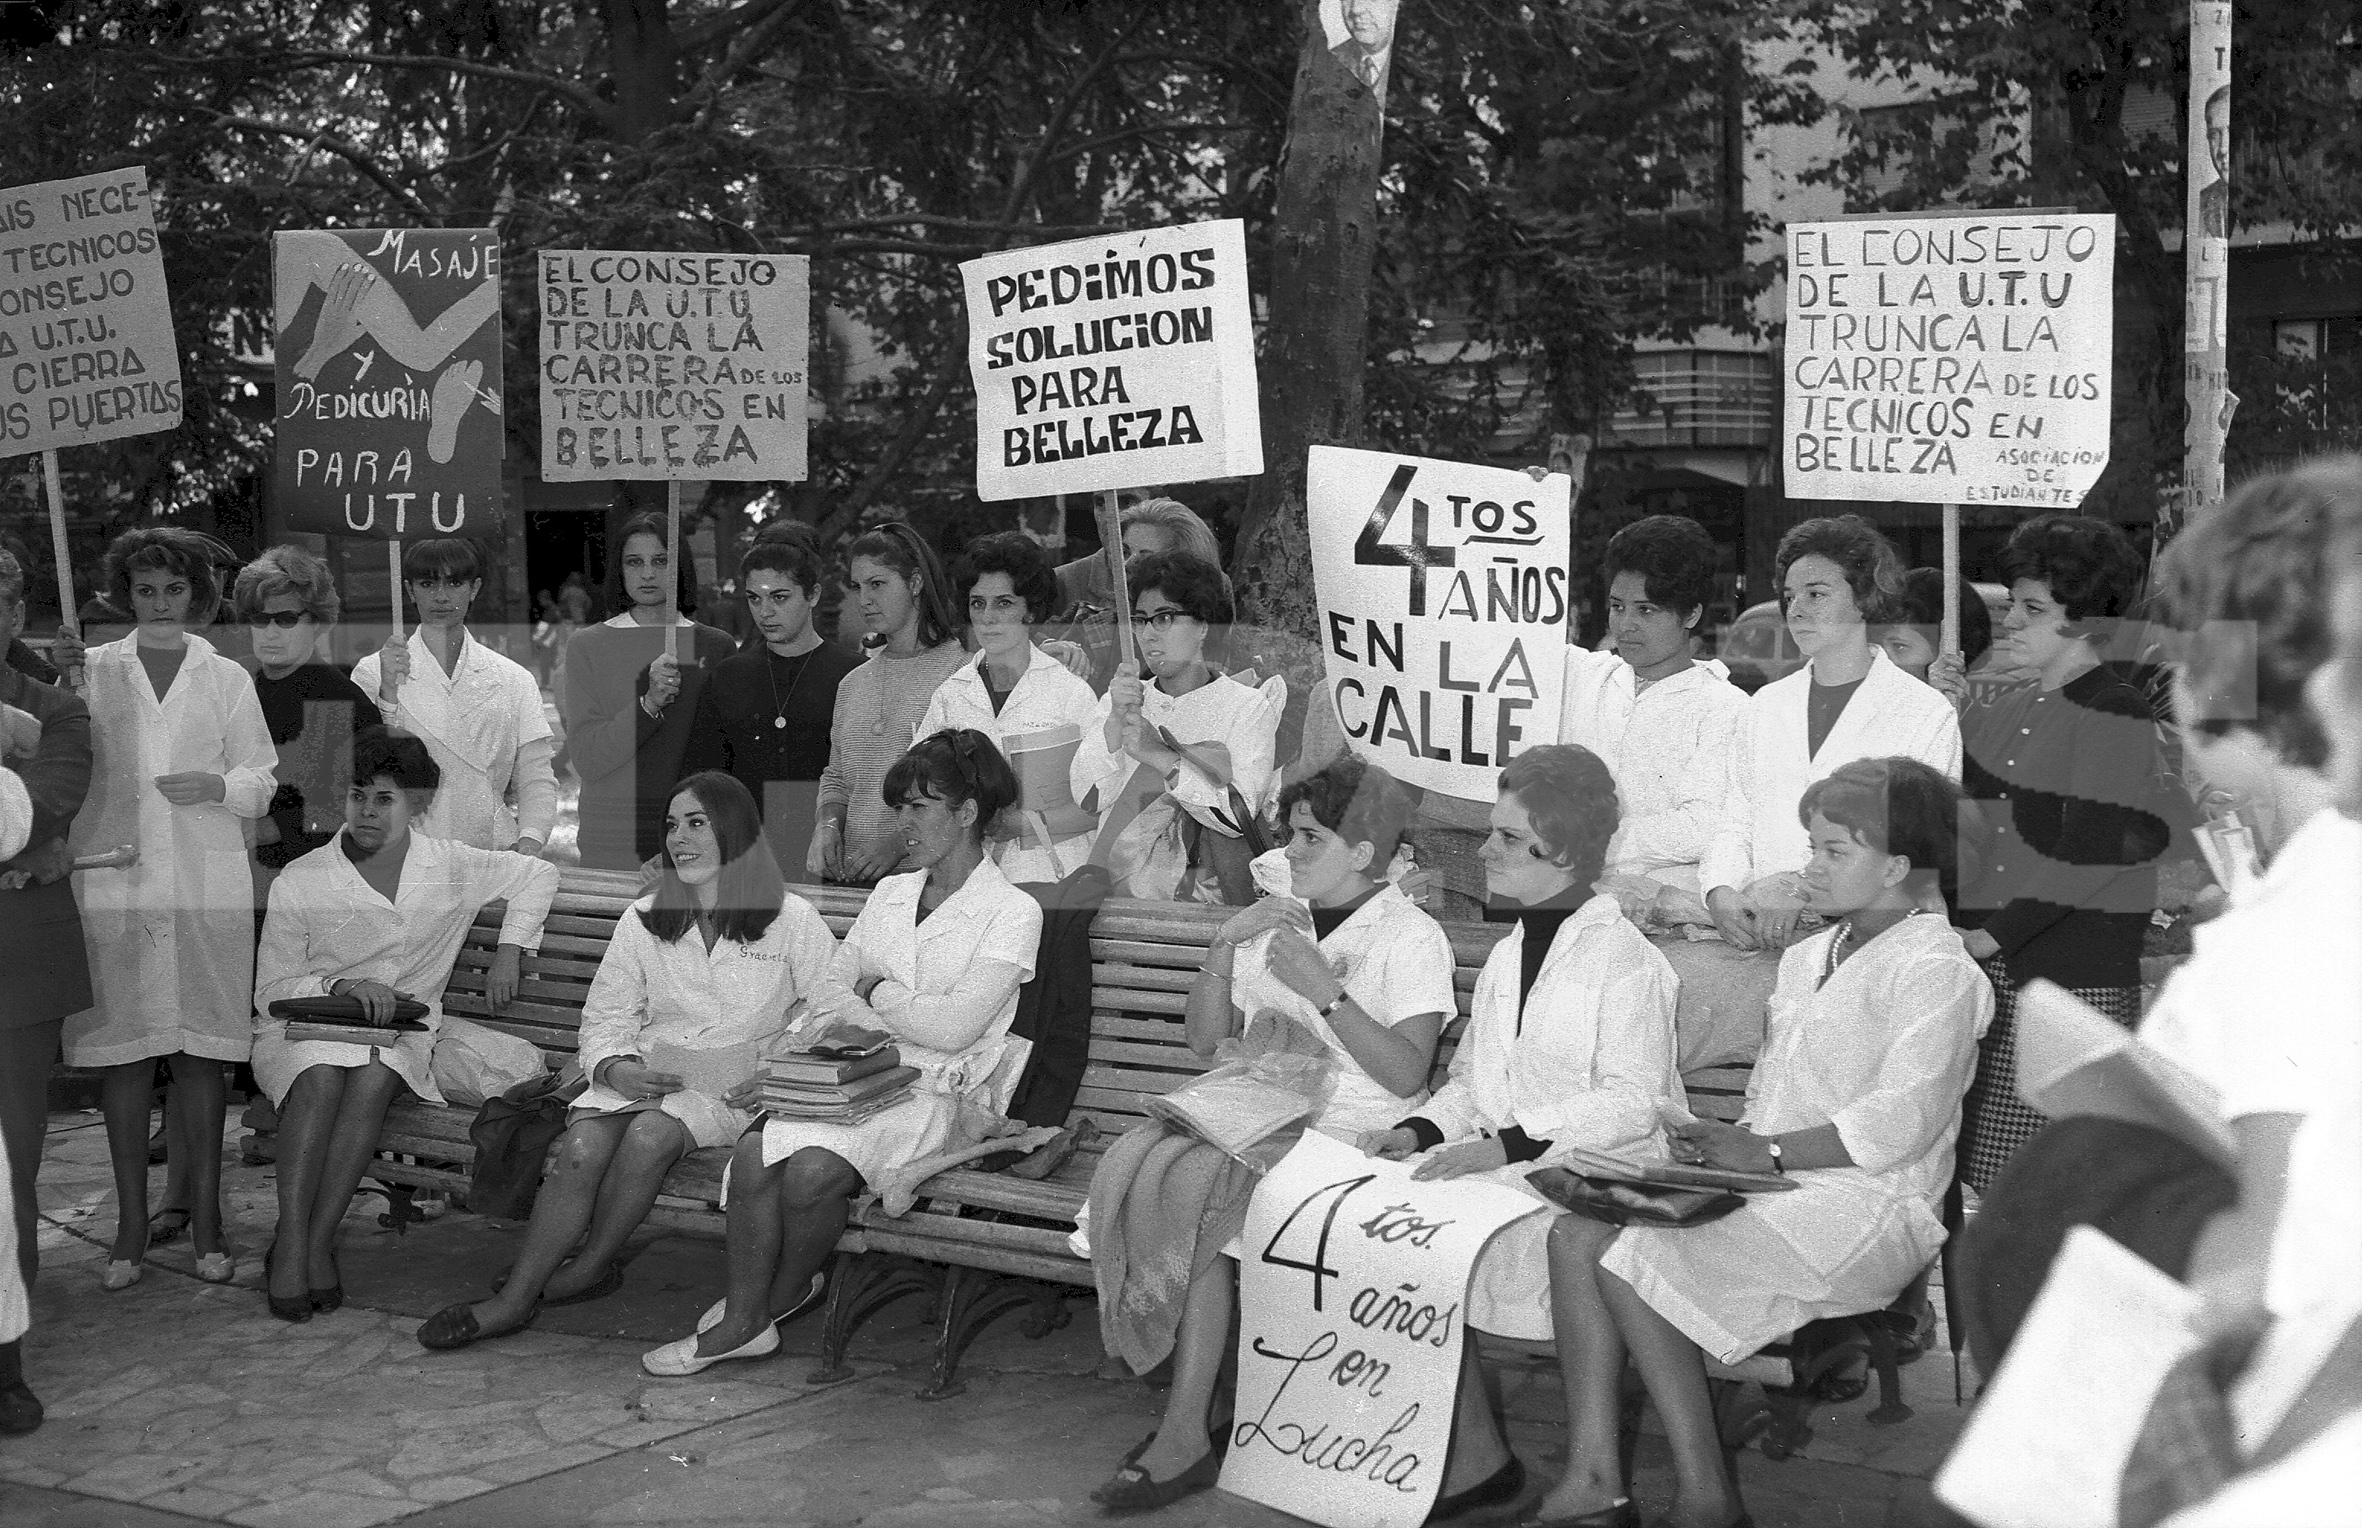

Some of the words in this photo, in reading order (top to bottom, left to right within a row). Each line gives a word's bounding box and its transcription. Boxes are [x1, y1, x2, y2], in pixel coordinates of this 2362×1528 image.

[61, 181, 150, 222] NECE-
[3, 227, 156, 273] TECNICOS
[1796, 231, 1845, 266] EL
[1863, 225, 2096, 266] CONSEJO
[546, 256, 583, 283] EL
[590, 257, 776, 286] CONSEJO
[1799, 273, 1848, 308] DE
[1878, 271, 1936, 307] LA
[547, 287, 589, 317] DE
[605, 287, 649, 318] LA
[32, 315, 116, 350] U.T.U.
[546, 320, 692, 351] TRUNCA
[707, 318, 764, 351] LA
[1799, 313, 1986, 352] TRUNCA
[2003, 314, 2059, 352] LA
[13, 347, 145, 394] CIERRA
[545, 353, 737, 386] CARRERA
[740, 368, 765, 385] DE
[772, 371, 802, 384] LOS
[1012, 366, 1131, 415] PARA
[1795, 356, 1993, 395] CARRERA
[2004, 374, 2037, 397] DE
[2049, 373, 2099, 400] LOS
[49, 379, 181, 431] PUERTAS
[553, 388, 725, 421] TECNICOS
[743, 393, 785, 421] EN
[556, 424, 758, 468] BELLEZA
[1004, 405, 1204, 467] BELLEZA
[1989, 413, 2043, 439] EN
[297, 448, 412, 487] PARA
[1795, 433, 1957, 475] BELLEZA
[2026, 468, 2054, 482] DE
[345, 491, 465, 532] UTU
[1438, 557, 1566, 625] AÑOS
[1328, 610, 1404, 672] EN
[1439, 637, 1539, 699] LA
[1335, 677, 1533, 767] CALLE
[1261, 1174, 1377, 1311] 4
[1349, 1283, 1458, 1347] años
[1329, 1349, 1391, 1397] en
[1234, 1331, 1421, 1493] Lucha
